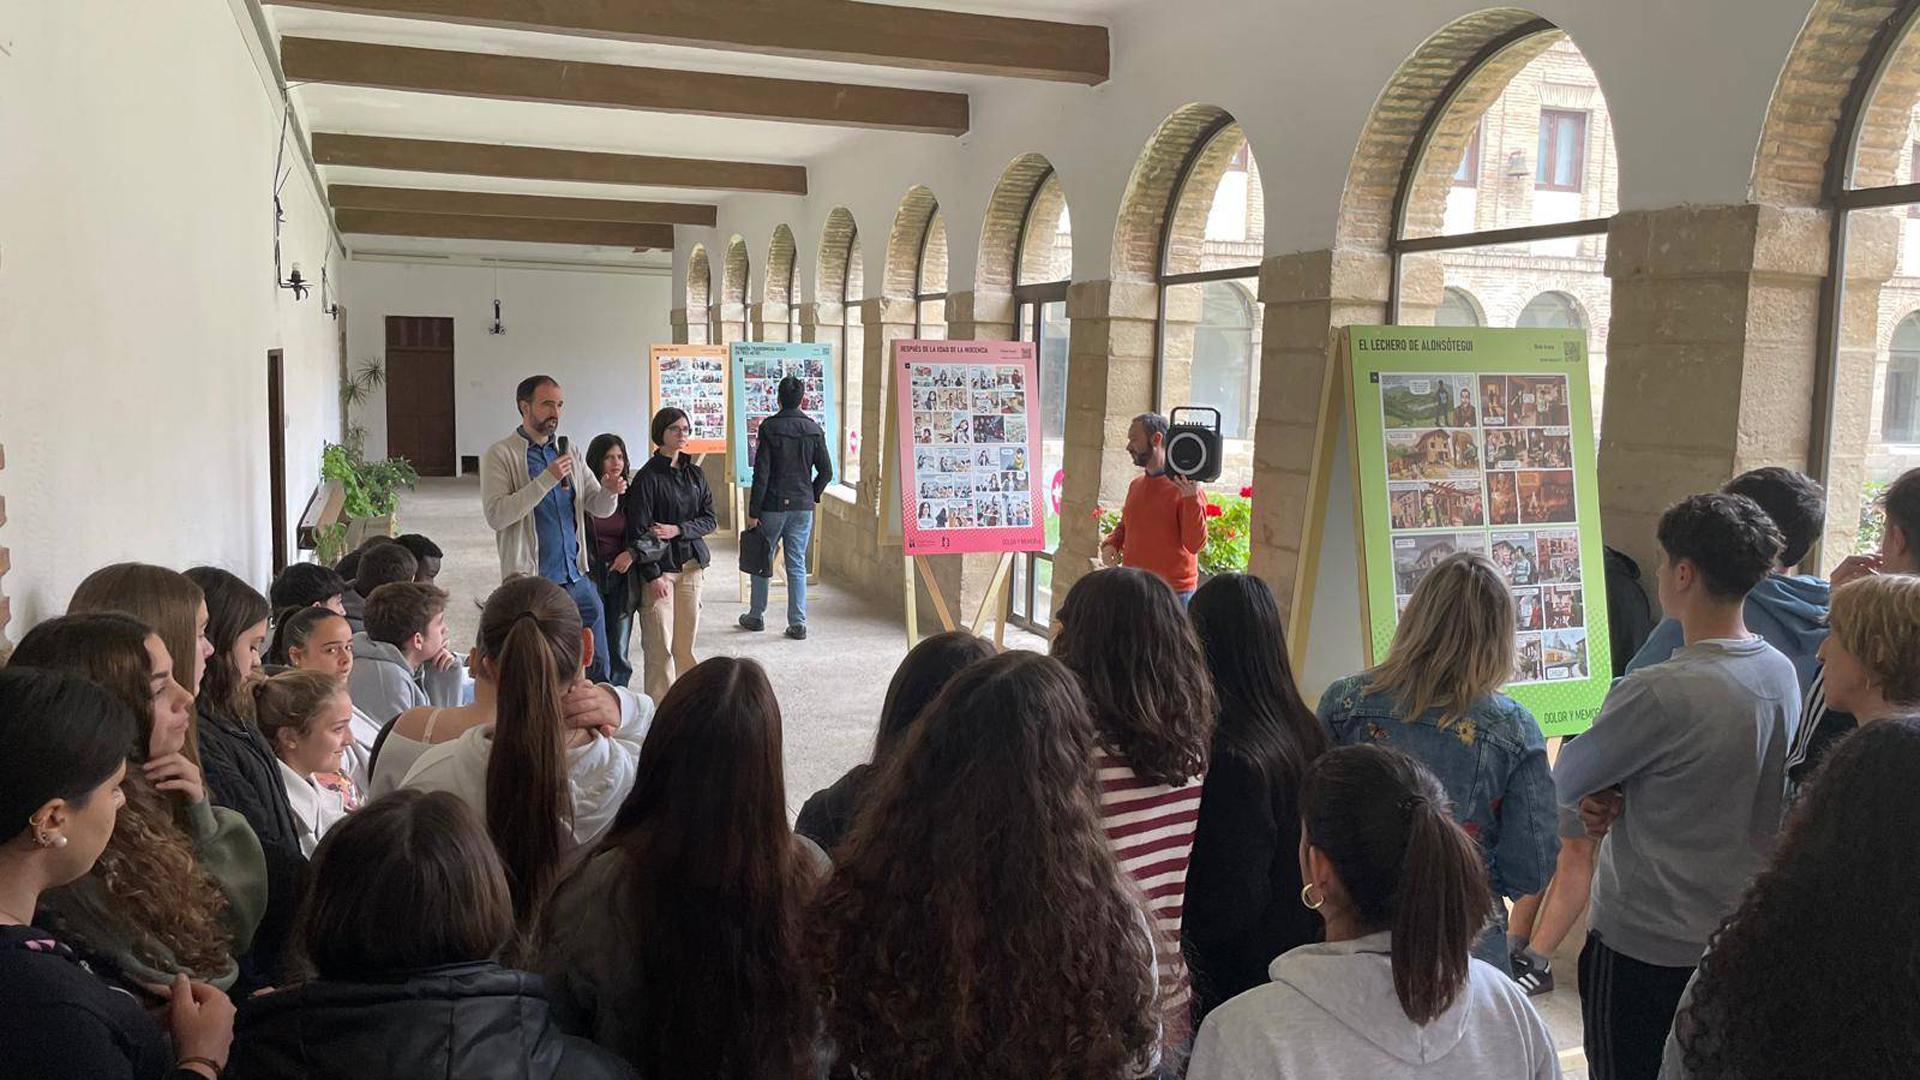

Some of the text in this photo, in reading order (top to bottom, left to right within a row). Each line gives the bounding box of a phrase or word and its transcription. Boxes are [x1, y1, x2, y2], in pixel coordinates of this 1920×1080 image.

[1359, 337, 1473, 351] EL LECHERO DE ALONSÓTEGUI
[1544, 710, 1568, 724] DOLOR
[1568, 710, 1574, 721] Y
